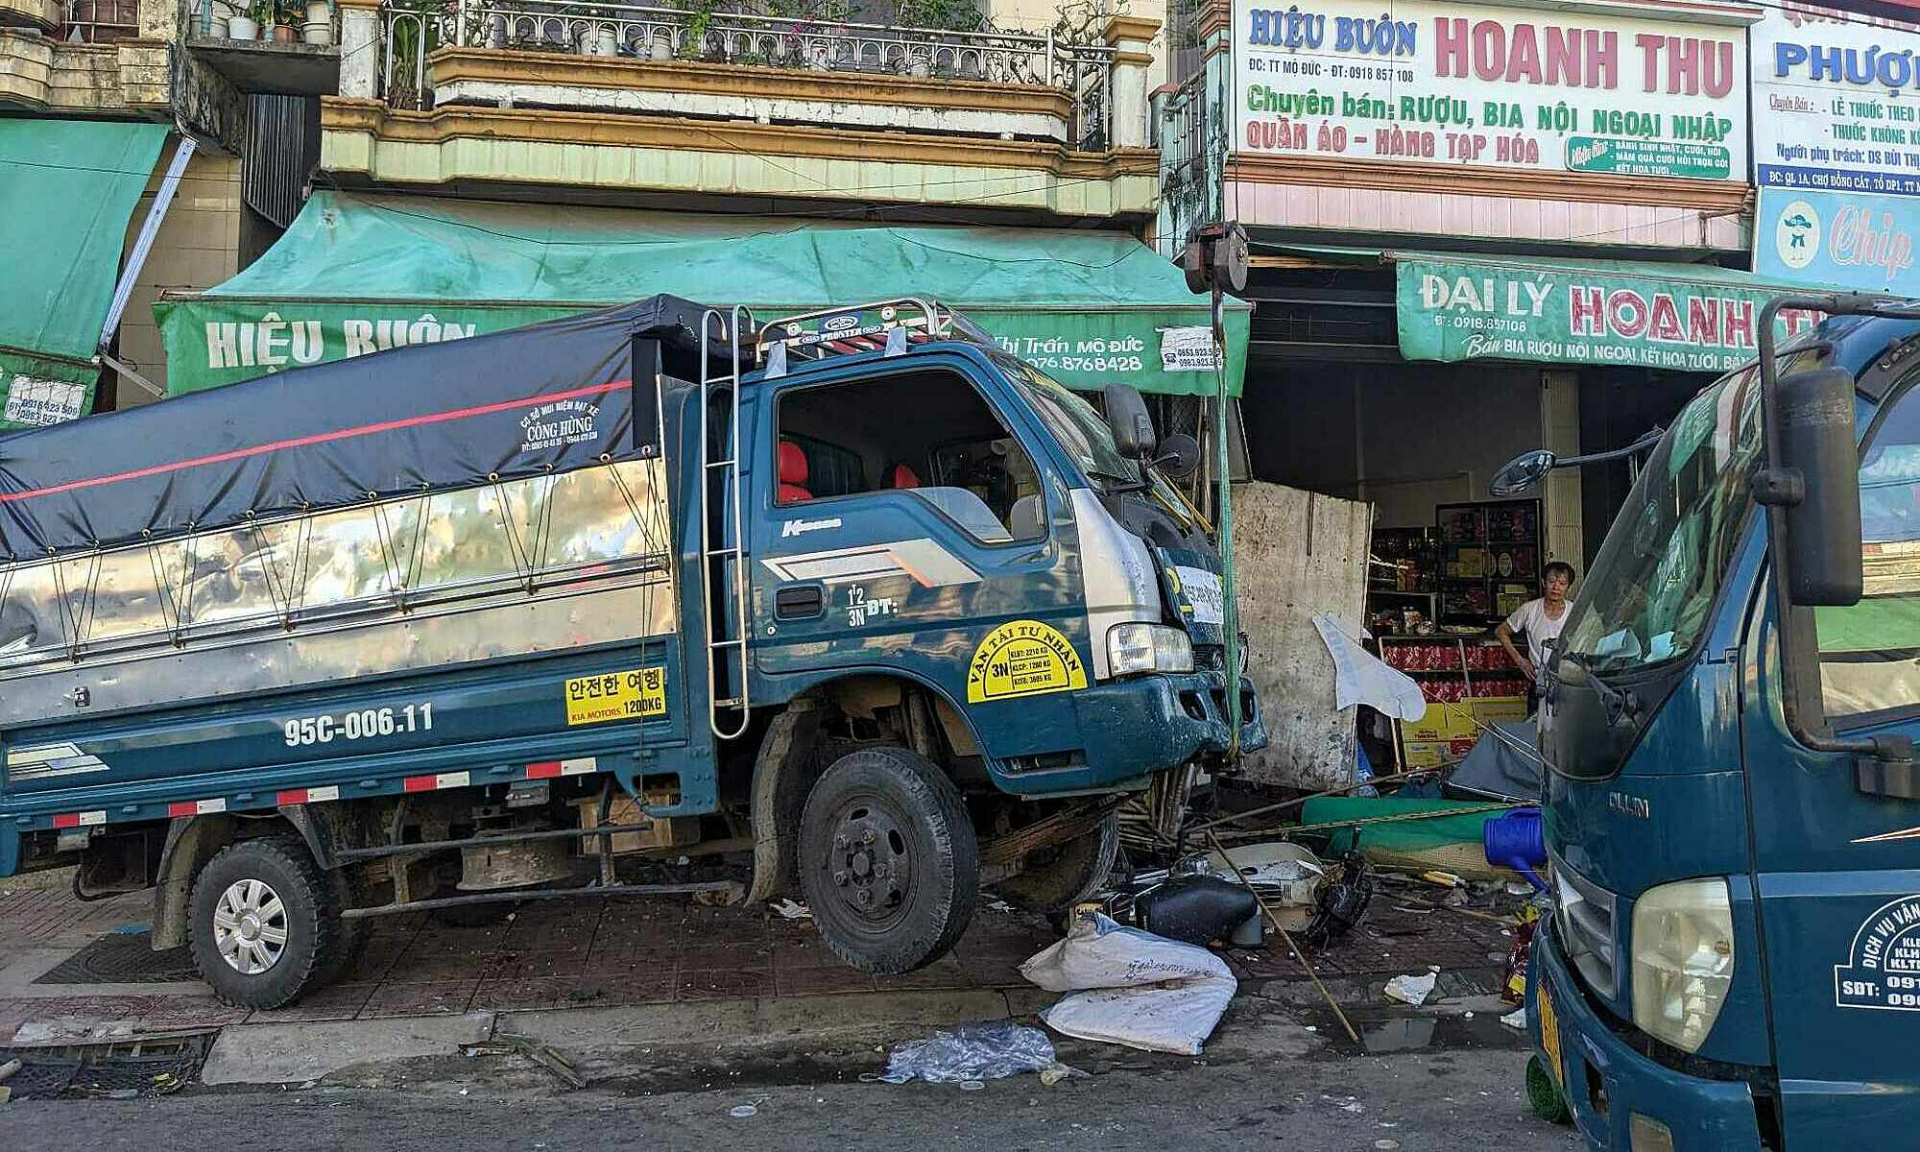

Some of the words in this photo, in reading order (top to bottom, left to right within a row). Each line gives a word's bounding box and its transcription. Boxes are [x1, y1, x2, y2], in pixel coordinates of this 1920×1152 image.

[1250, 5, 1326, 54] HIỆU
[1334, 13, 1418, 57] BUÔN
[1249, 58, 1266, 72] ĐC:
[1269, 60, 1281, 73] TT
[1283, 60, 1299, 78] MỘ
[1301, 59, 1321, 77] ĐỨC
[1331, 63, 1348, 78] ĐT:
[1350, 65, 1373, 79] 0918
[1376, 67, 1394, 82] 857
[1397, 70, 1414, 83] 108
[1434, 16, 1618, 90] HOANH
[1635, 33, 1734, 99] THU
[1774, 42, 1920, 97] PHƯỢ
[1247, 84, 1335, 119] Chuyên
[1342, 91, 1395, 120] bán:
[1400, 95, 1474, 129] RƯỢU,
[1483, 101, 1524, 129] BIA
[1537, 101, 1578, 137] NỘI
[1592, 109, 1662, 141] NGOẠI
[1672, 111, 1733, 145] NHẬP
[1849, 98, 1884, 119] THUỐC
[1887, 104, 1915, 122] THEO
[1246, 115, 1309, 150] QUẦN
[1317, 119, 1347, 153] ÁO
[1375, 124, 1435, 158] HÀNG
[1446, 132, 1488, 164] TẠP
[1496, 132, 1539, 164] HÓA
[1831, 121, 1866, 141] THUỐC
[1871, 126, 1906, 145] KHÔNG
[1810, 146, 1830, 163] phụ
[1868, 150, 1882, 165] DS
[1785, 173, 1797, 185] QL
[1830, 203, 1913, 281] Chip
[1418, 274, 1495, 315] ĐẠI
[1507, 273, 1554, 318] LÝ
[1569, 284, 1755, 349] HOANH
[206, 312, 324, 373] HIỆU
[1023, 336, 1069, 354] Trấn
[1077, 338, 1105, 356] MỘ
[1108, 335, 1145, 352] ĐỨC
[1462, 333, 1500, 357] Bán
[1504, 338, 1524, 354] BIA
[1527, 340, 1562, 360] RƯỢU
[1566, 341, 1590, 359] NỘI
[1641, 346, 1660, 364] KẾT
[1662, 351, 1686, 367] HOA
[527, 421, 558, 441] CÔNG
[560, 415, 593, 436] HÙNG
[849, 608, 865, 627] 3N
[970, 649, 990, 684] VẬN
[989, 628, 1014, 648] TẢI
[1018, 625, 1041, 636] TƯ
[1044, 631, 1080, 672] NHÂN
[992, 662, 1009, 678] 3N
[570, 674, 619, 700] 안전한
[627, 669, 660, 692] 여행
[285, 702, 433, 747] 95C-006.11
[587, 707, 621, 719] MOTORS
[624, 697, 662, 714] 1200KG
[1862, 935, 1883, 968] DỊCH
[1875, 917, 1896, 937] VỤ
